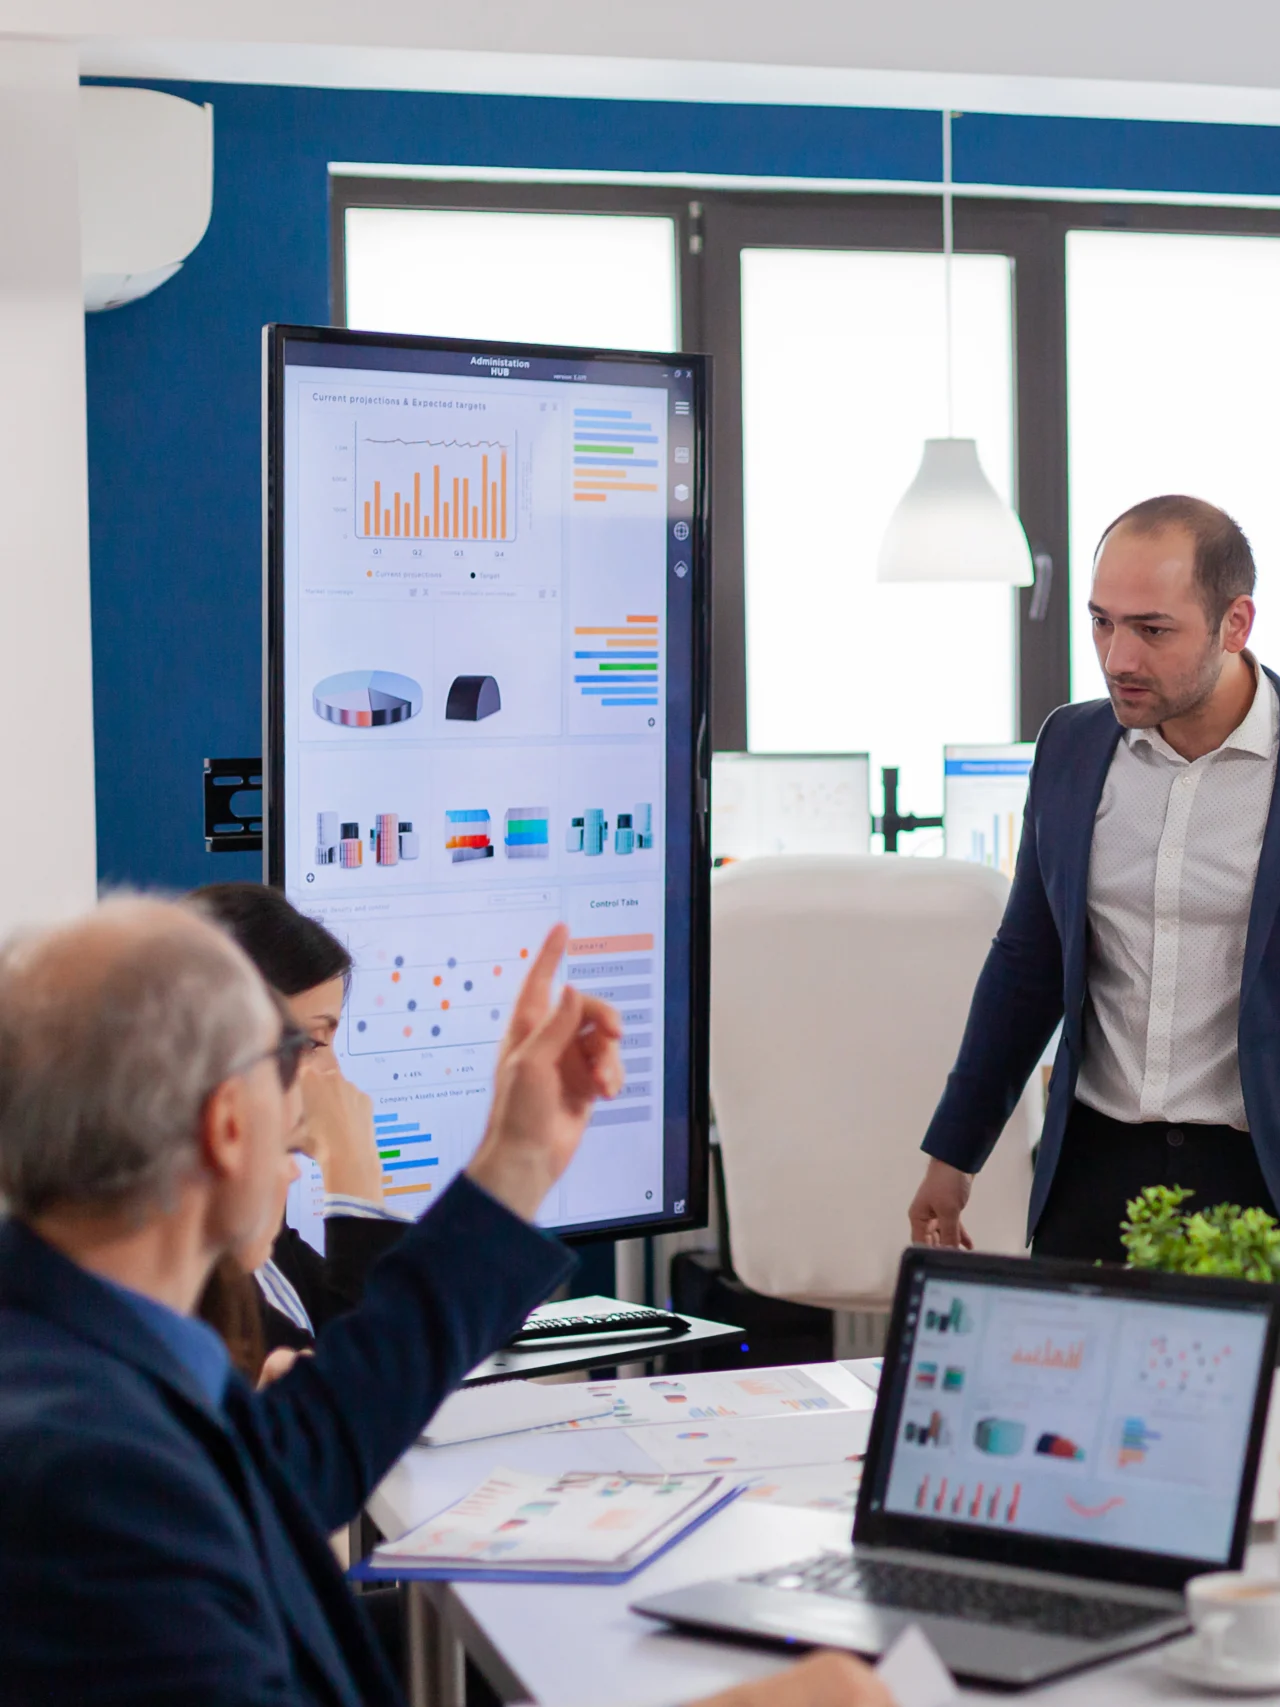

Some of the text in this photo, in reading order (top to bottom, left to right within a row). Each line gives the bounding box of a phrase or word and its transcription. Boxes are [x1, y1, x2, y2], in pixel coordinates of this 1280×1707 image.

[470, 357, 530, 369] Administation
[490, 367, 510, 377] HUB
[312, 392, 487, 412] Current projections & Expected targets
[373, 548, 382, 556] Q1
[412, 549, 423, 557] Q2
[375, 570, 442, 580] Current projections
[479, 572, 500, 580] Target
[590, 898, 639, 909] Control Tabs
[379, 1093, 413, 1104] Company's
[415, 1091, 435, 1100] Assets
[436, 1090, 448, 1099] and
[449, 1088, 463, 1098] their
